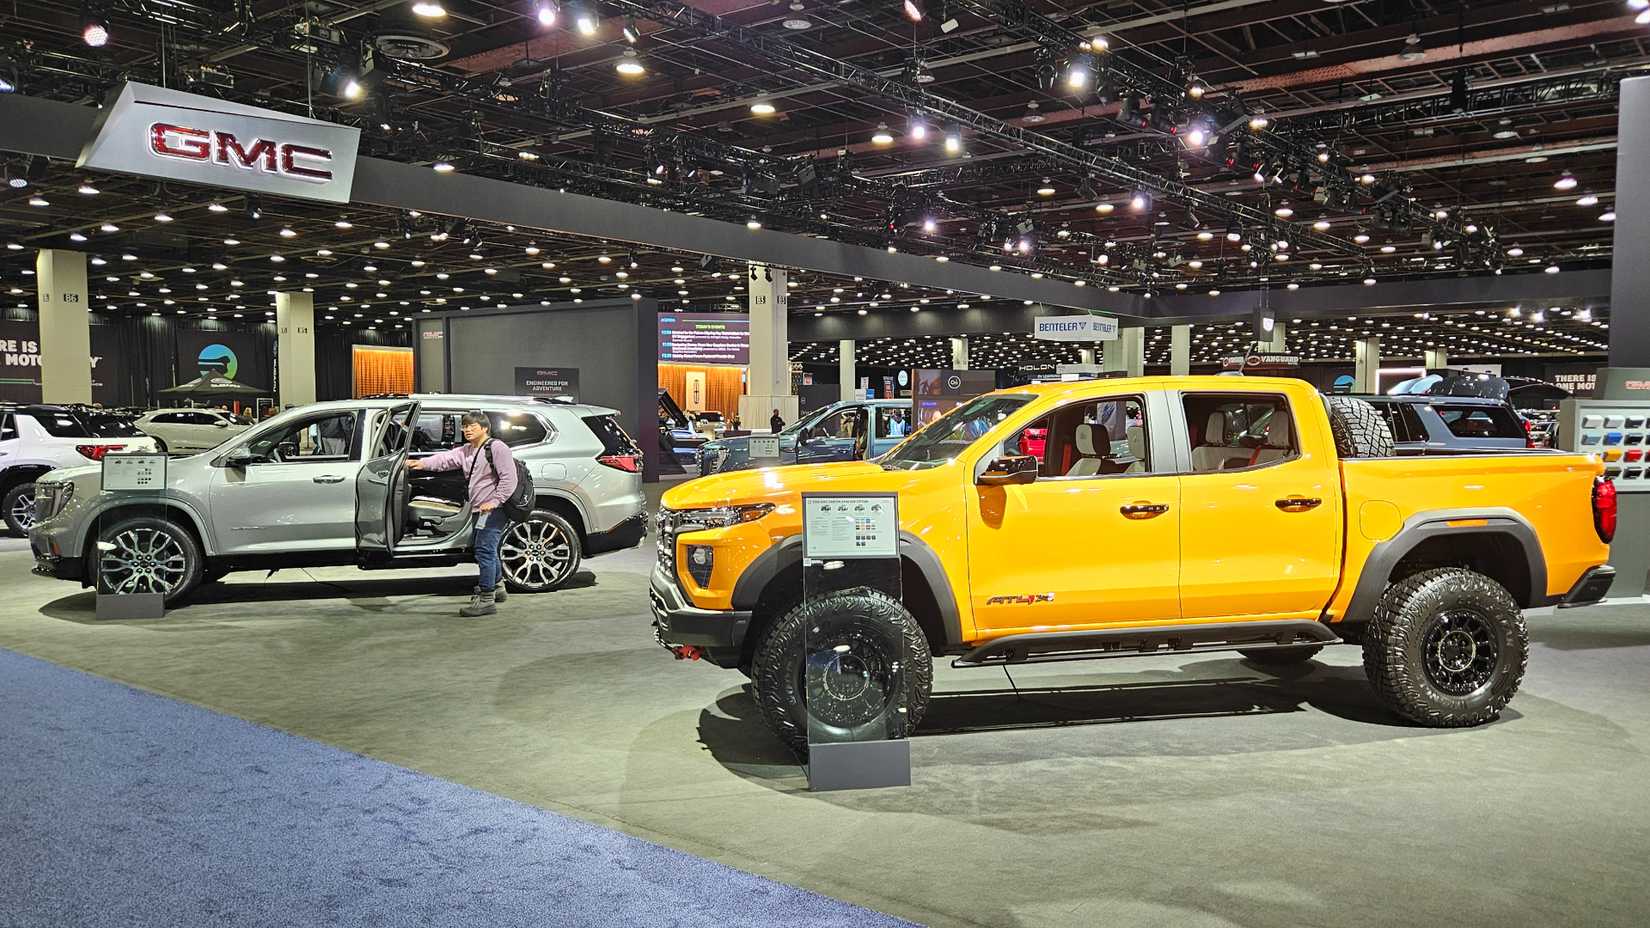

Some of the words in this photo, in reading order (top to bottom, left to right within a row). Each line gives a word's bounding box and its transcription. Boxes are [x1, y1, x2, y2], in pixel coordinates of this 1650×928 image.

[148, 121, 333, 184] GMC
[1039, 322, 1078, 332] BENTELER
[21, 341, 38, 354] IS
[1260, 355, 1299, 363] VANGUARD
[1018, 364, 1056, 372] HOLON
[1555, 374, 1585, 382] THERE
